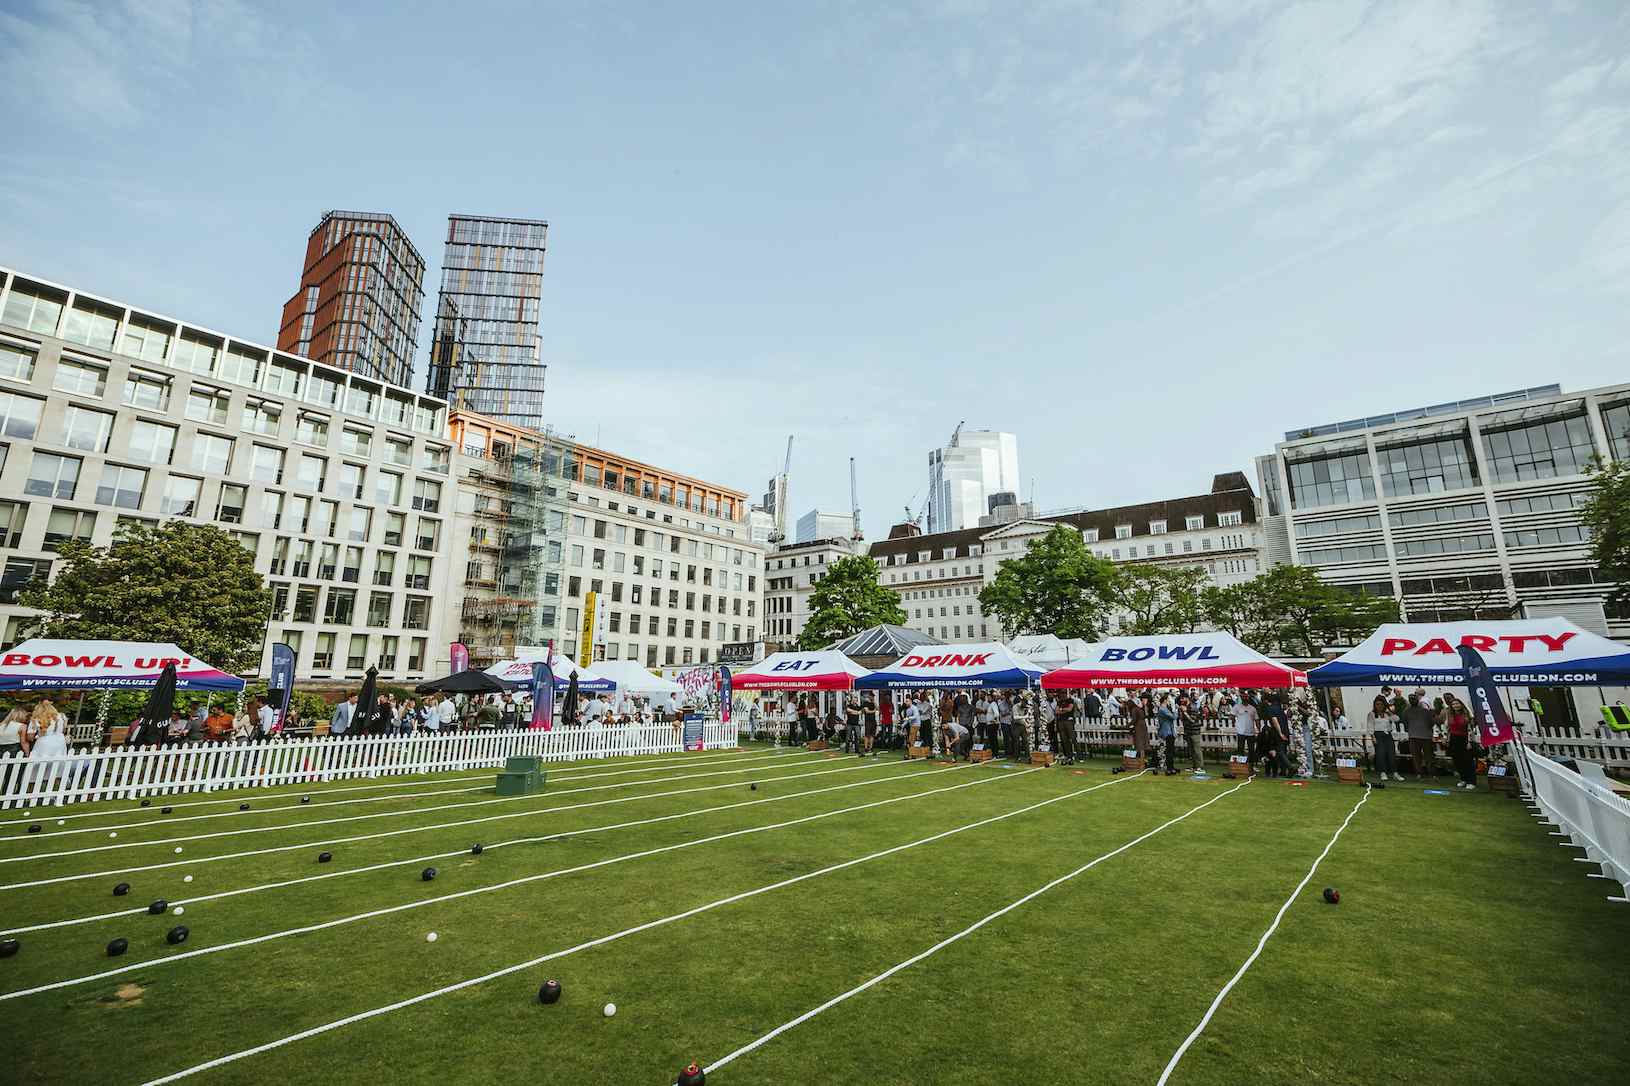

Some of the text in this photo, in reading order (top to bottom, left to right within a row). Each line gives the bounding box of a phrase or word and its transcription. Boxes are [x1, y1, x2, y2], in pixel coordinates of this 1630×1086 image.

[1380, 632, 1577, 656] PARTY
[1099, 646, 1220, 661] BOWL
[1, 654, 122, 667] BOWL
[771, 660, 820, 672] EAT
[900, 653, 994, 668] DRINK
[1090, 677, 1228, 685] WWW.THEBOWLSCLUBLDN.COM
[1378, 673, 1598, 682] WWW.THEBOCLUBLDN.COM
